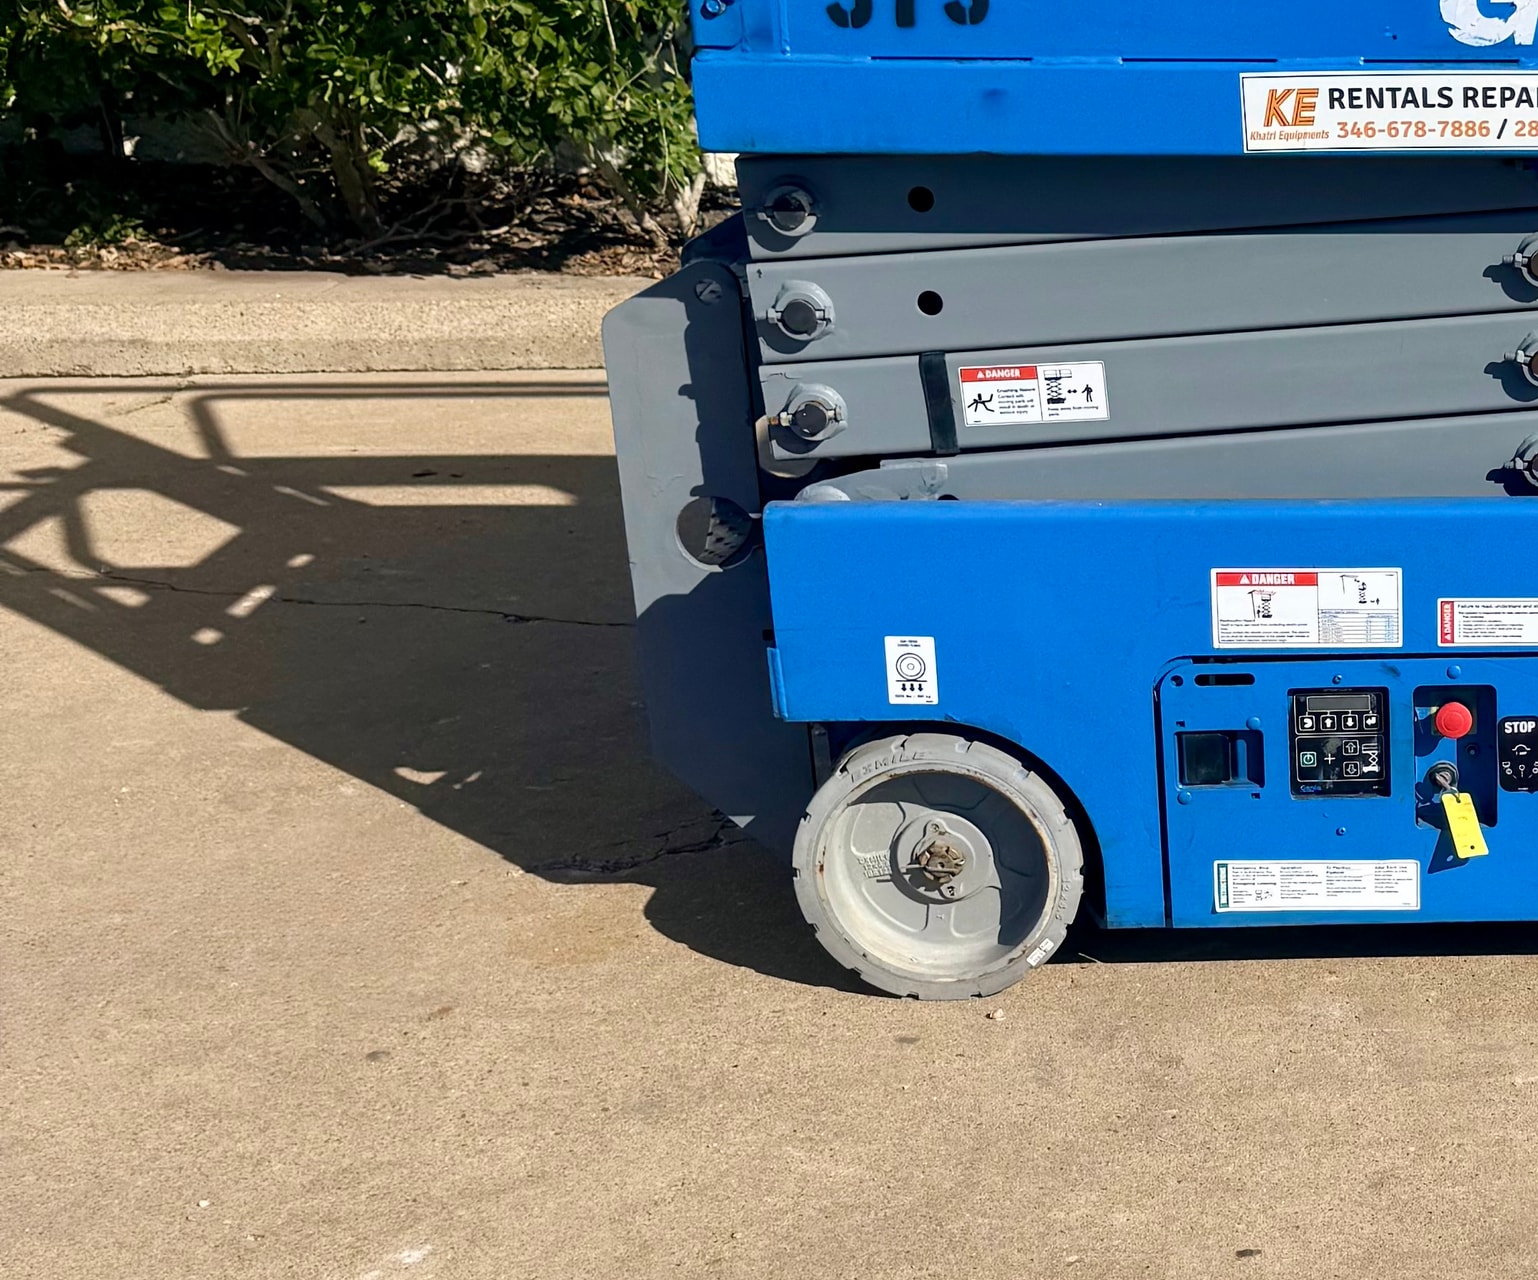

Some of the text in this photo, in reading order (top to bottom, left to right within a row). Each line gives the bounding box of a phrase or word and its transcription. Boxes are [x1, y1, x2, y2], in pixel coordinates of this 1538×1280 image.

[1328, 86, 1454, 110] RENTALS
[1263, 87, 1320, 128] KE
[1249, 129, 1330, 142] Khatri Equipments
[1336, 119, 1491, 139] 346-678-7886
[1496, 118, 1509, 140] /
[985, 368, 1021, 378] DANGER
[1251, 573, 1296, 585] DANGER
[1504, 721, 1536, 734] STOP
